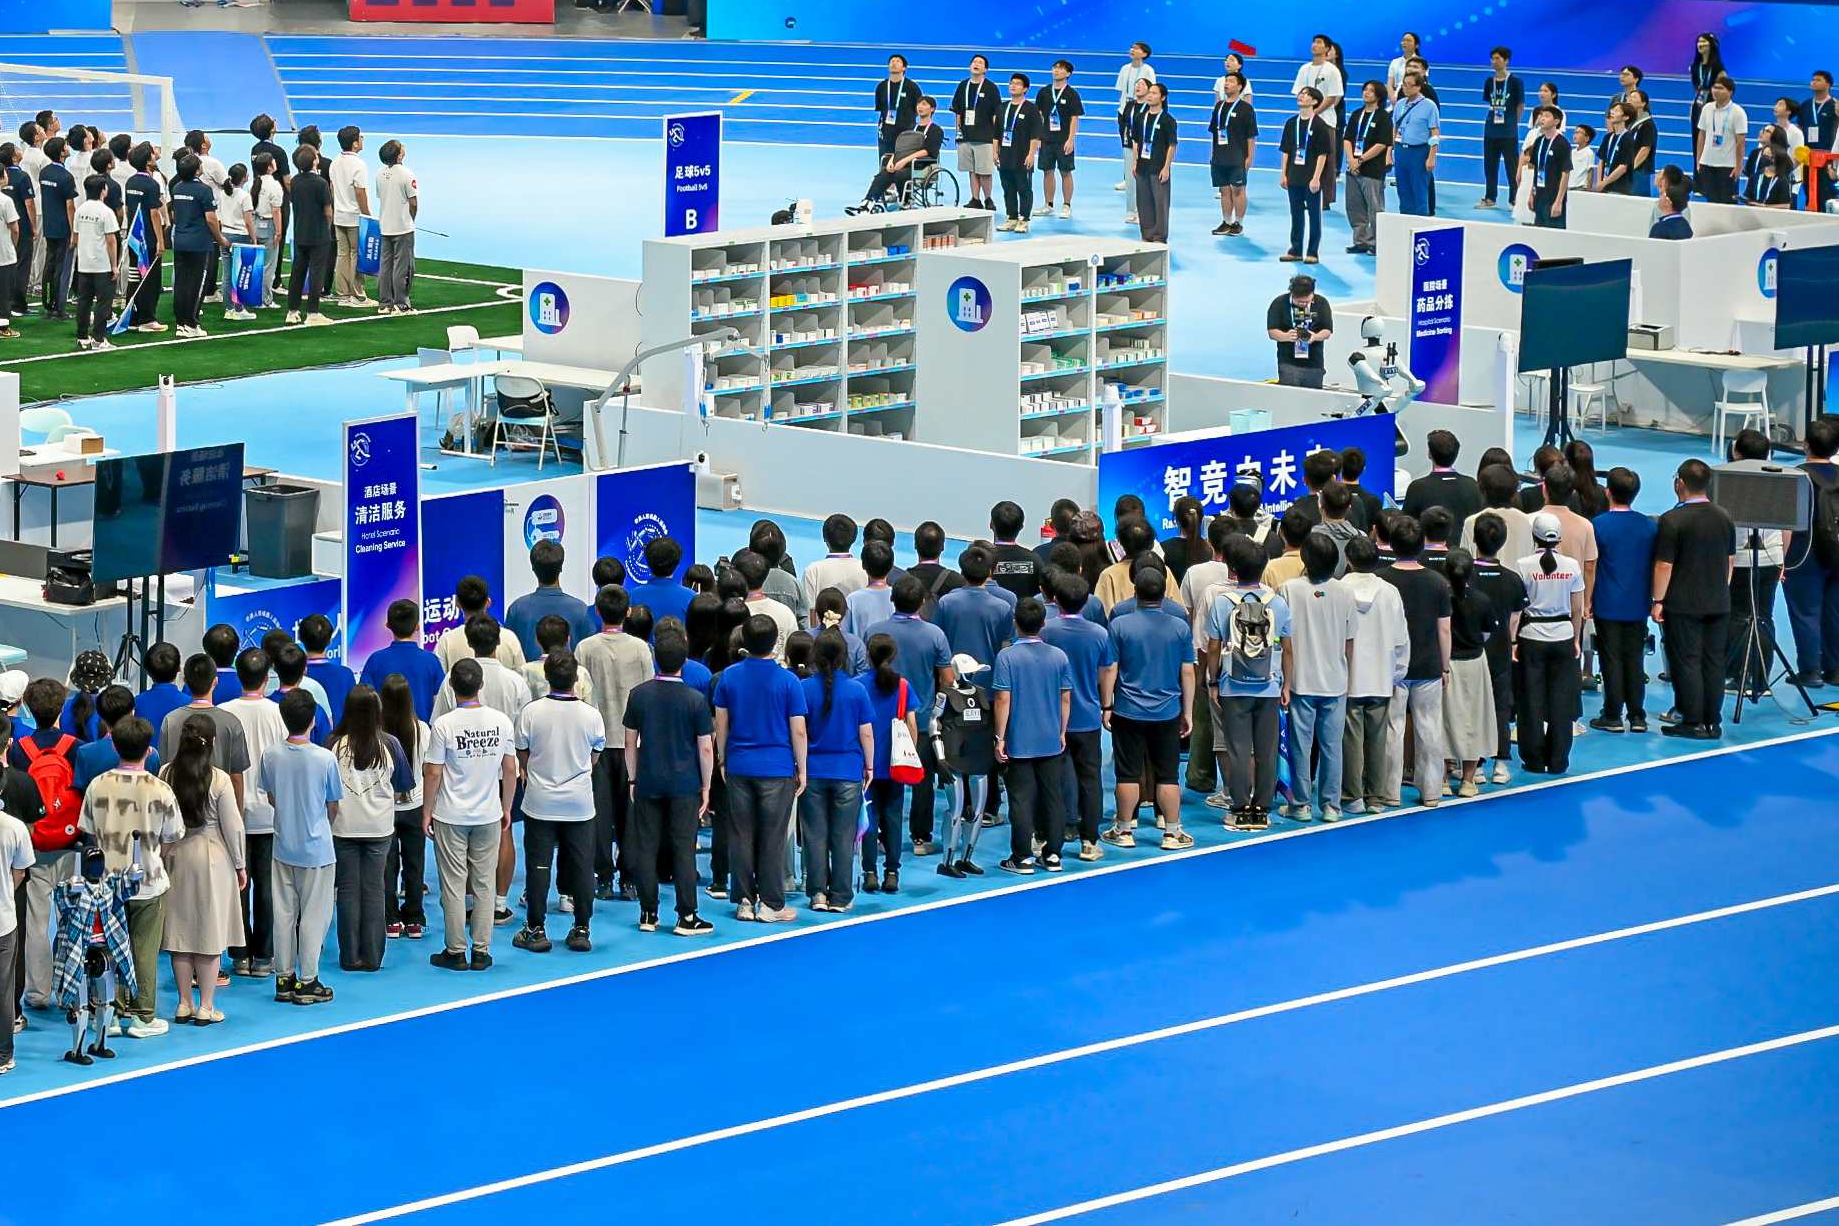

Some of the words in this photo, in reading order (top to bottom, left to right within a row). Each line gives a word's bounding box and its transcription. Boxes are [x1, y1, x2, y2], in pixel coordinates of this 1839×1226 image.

[675, 165, 711, 179] 足球5v5
[685, 209, 698, 230] B
[1417, 294, 1454, 313] 药品分拣
[364, 482, 397, 499] 酒店场景
[355, 500, 406, 525] 清洁服务
[355, 543, 383, 553] Cleaning
[383, 539, 406, 550] Service
[464, 725, 500, 738] Natural
[455, 735, 500, 751] Breeze
